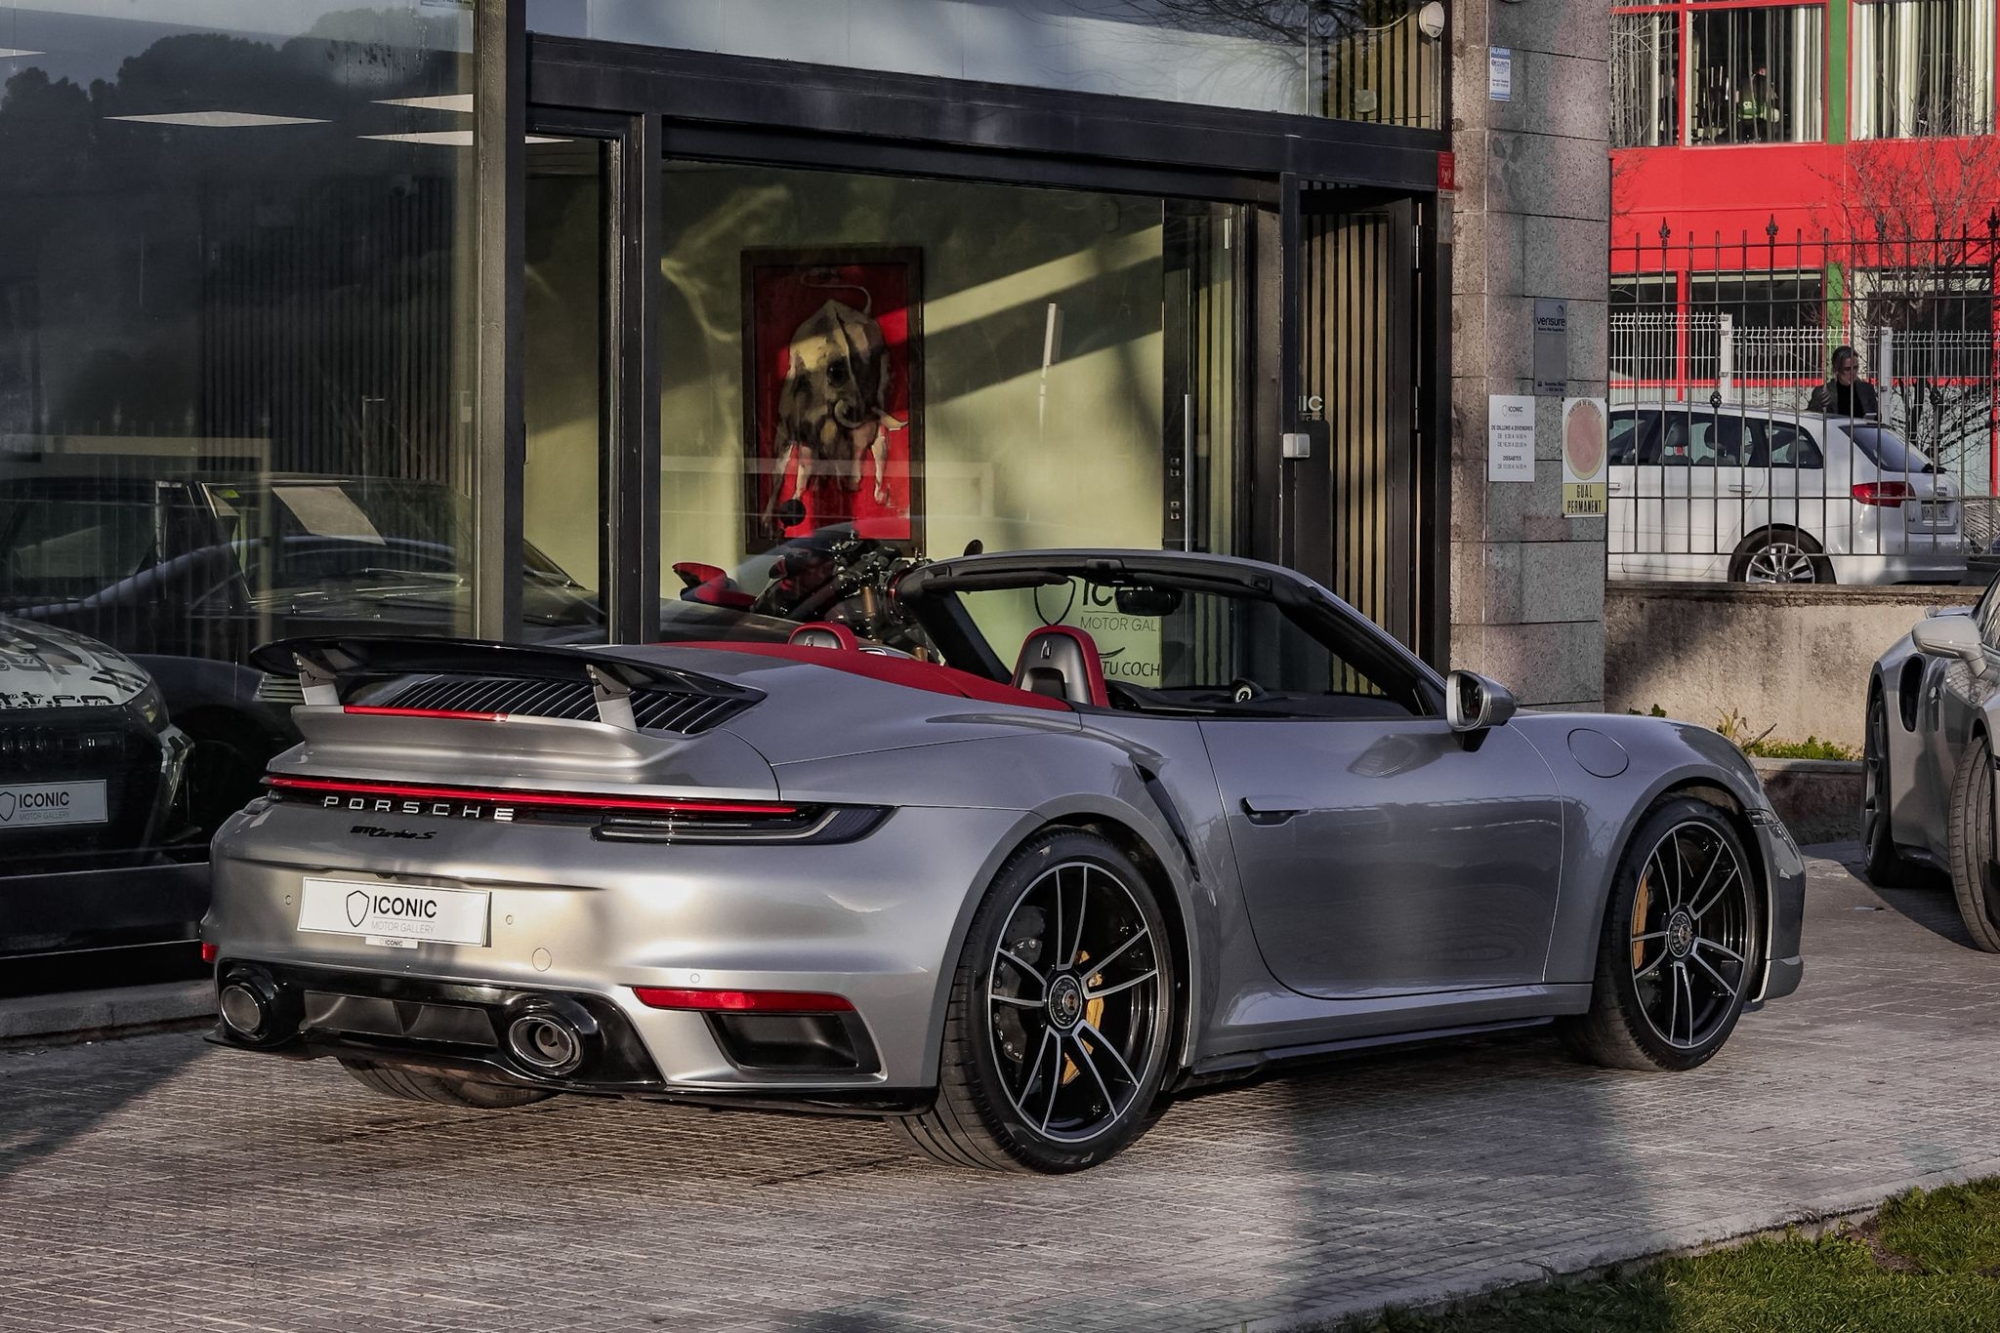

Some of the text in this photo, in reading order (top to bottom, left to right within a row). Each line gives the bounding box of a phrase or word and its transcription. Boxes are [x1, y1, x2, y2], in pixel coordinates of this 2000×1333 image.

[1536, 316, 1566, 327] verisure
[1576, 484, 1593, 498] GUAL
[1567, 499, 1602, 513] PERMANENT
[1080, 616, 1160, 632] MOTOR GAL
[1102, 661, 1160, 677] TU COCH
[19, 791, 70, 808] ICONIC
[19, 810, 70, 820] MOTOR GALLERY
[324, 796, 514, 821] PORSCHE
[373, 895, 438, 919] ICONIC
[371, 920, 436, 935] MOTOR GALLERY
